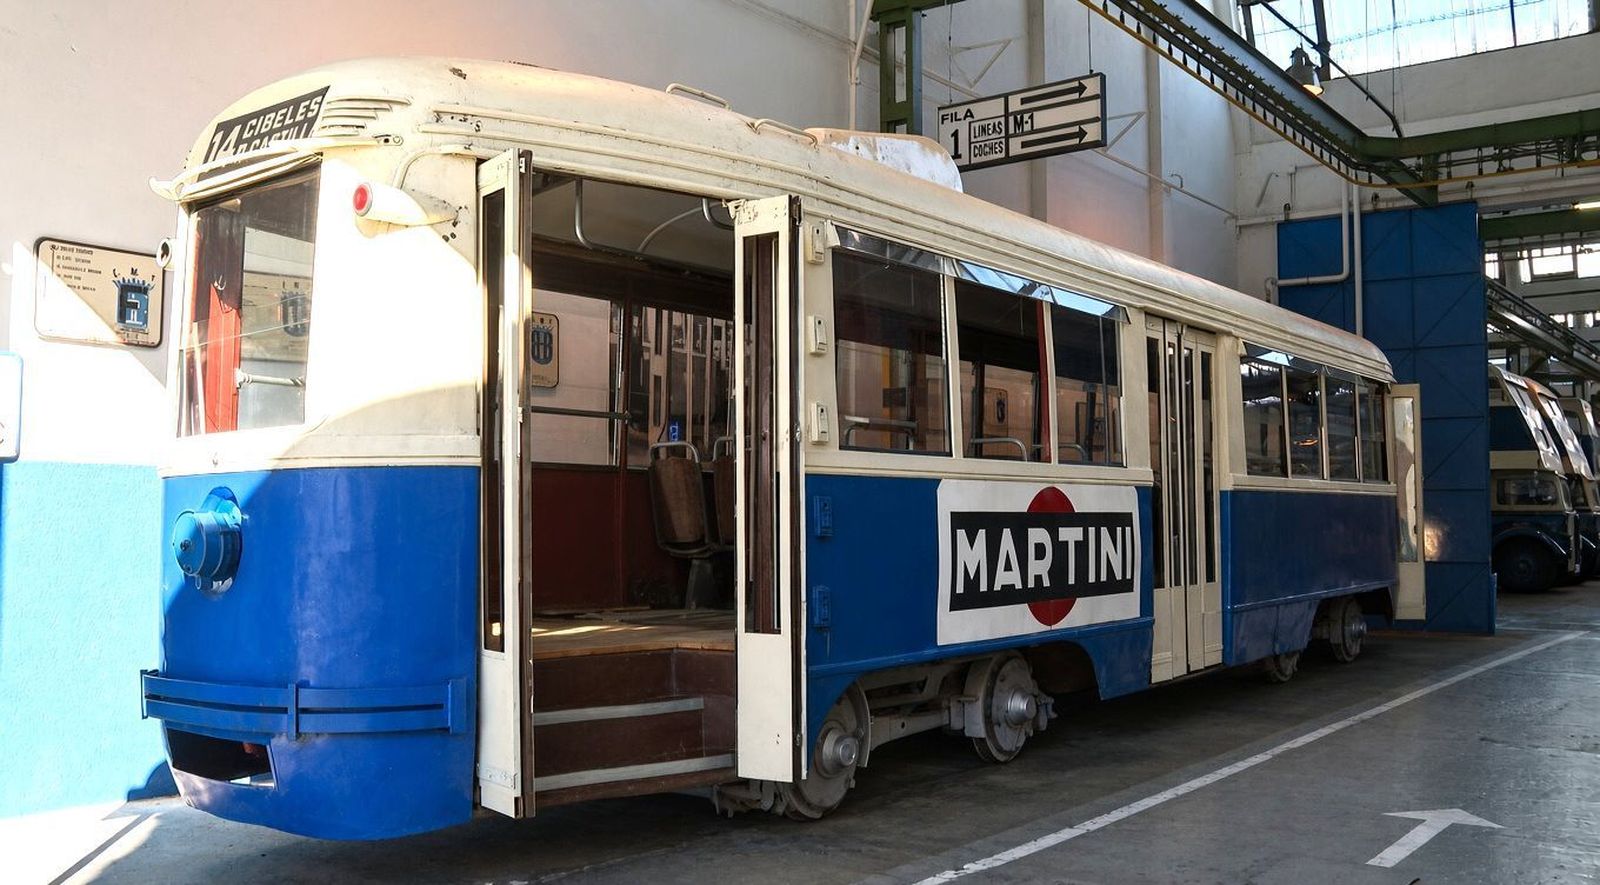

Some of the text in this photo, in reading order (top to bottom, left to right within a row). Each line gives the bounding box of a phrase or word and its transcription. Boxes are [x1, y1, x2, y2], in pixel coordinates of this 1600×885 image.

[242, 95, 323, 139] CIBELES
[941, 108, 975, 125] FILA
[973, 121, 1003, 139] LINEAS
[1013, 112, 1035, 134] M-1
[206, 123, 242, 162] 14
[951, 128, 962, 160] 1
[973, 141, 1004, 158] COCHES
[956, 526, 1132, 594] MARTINI
